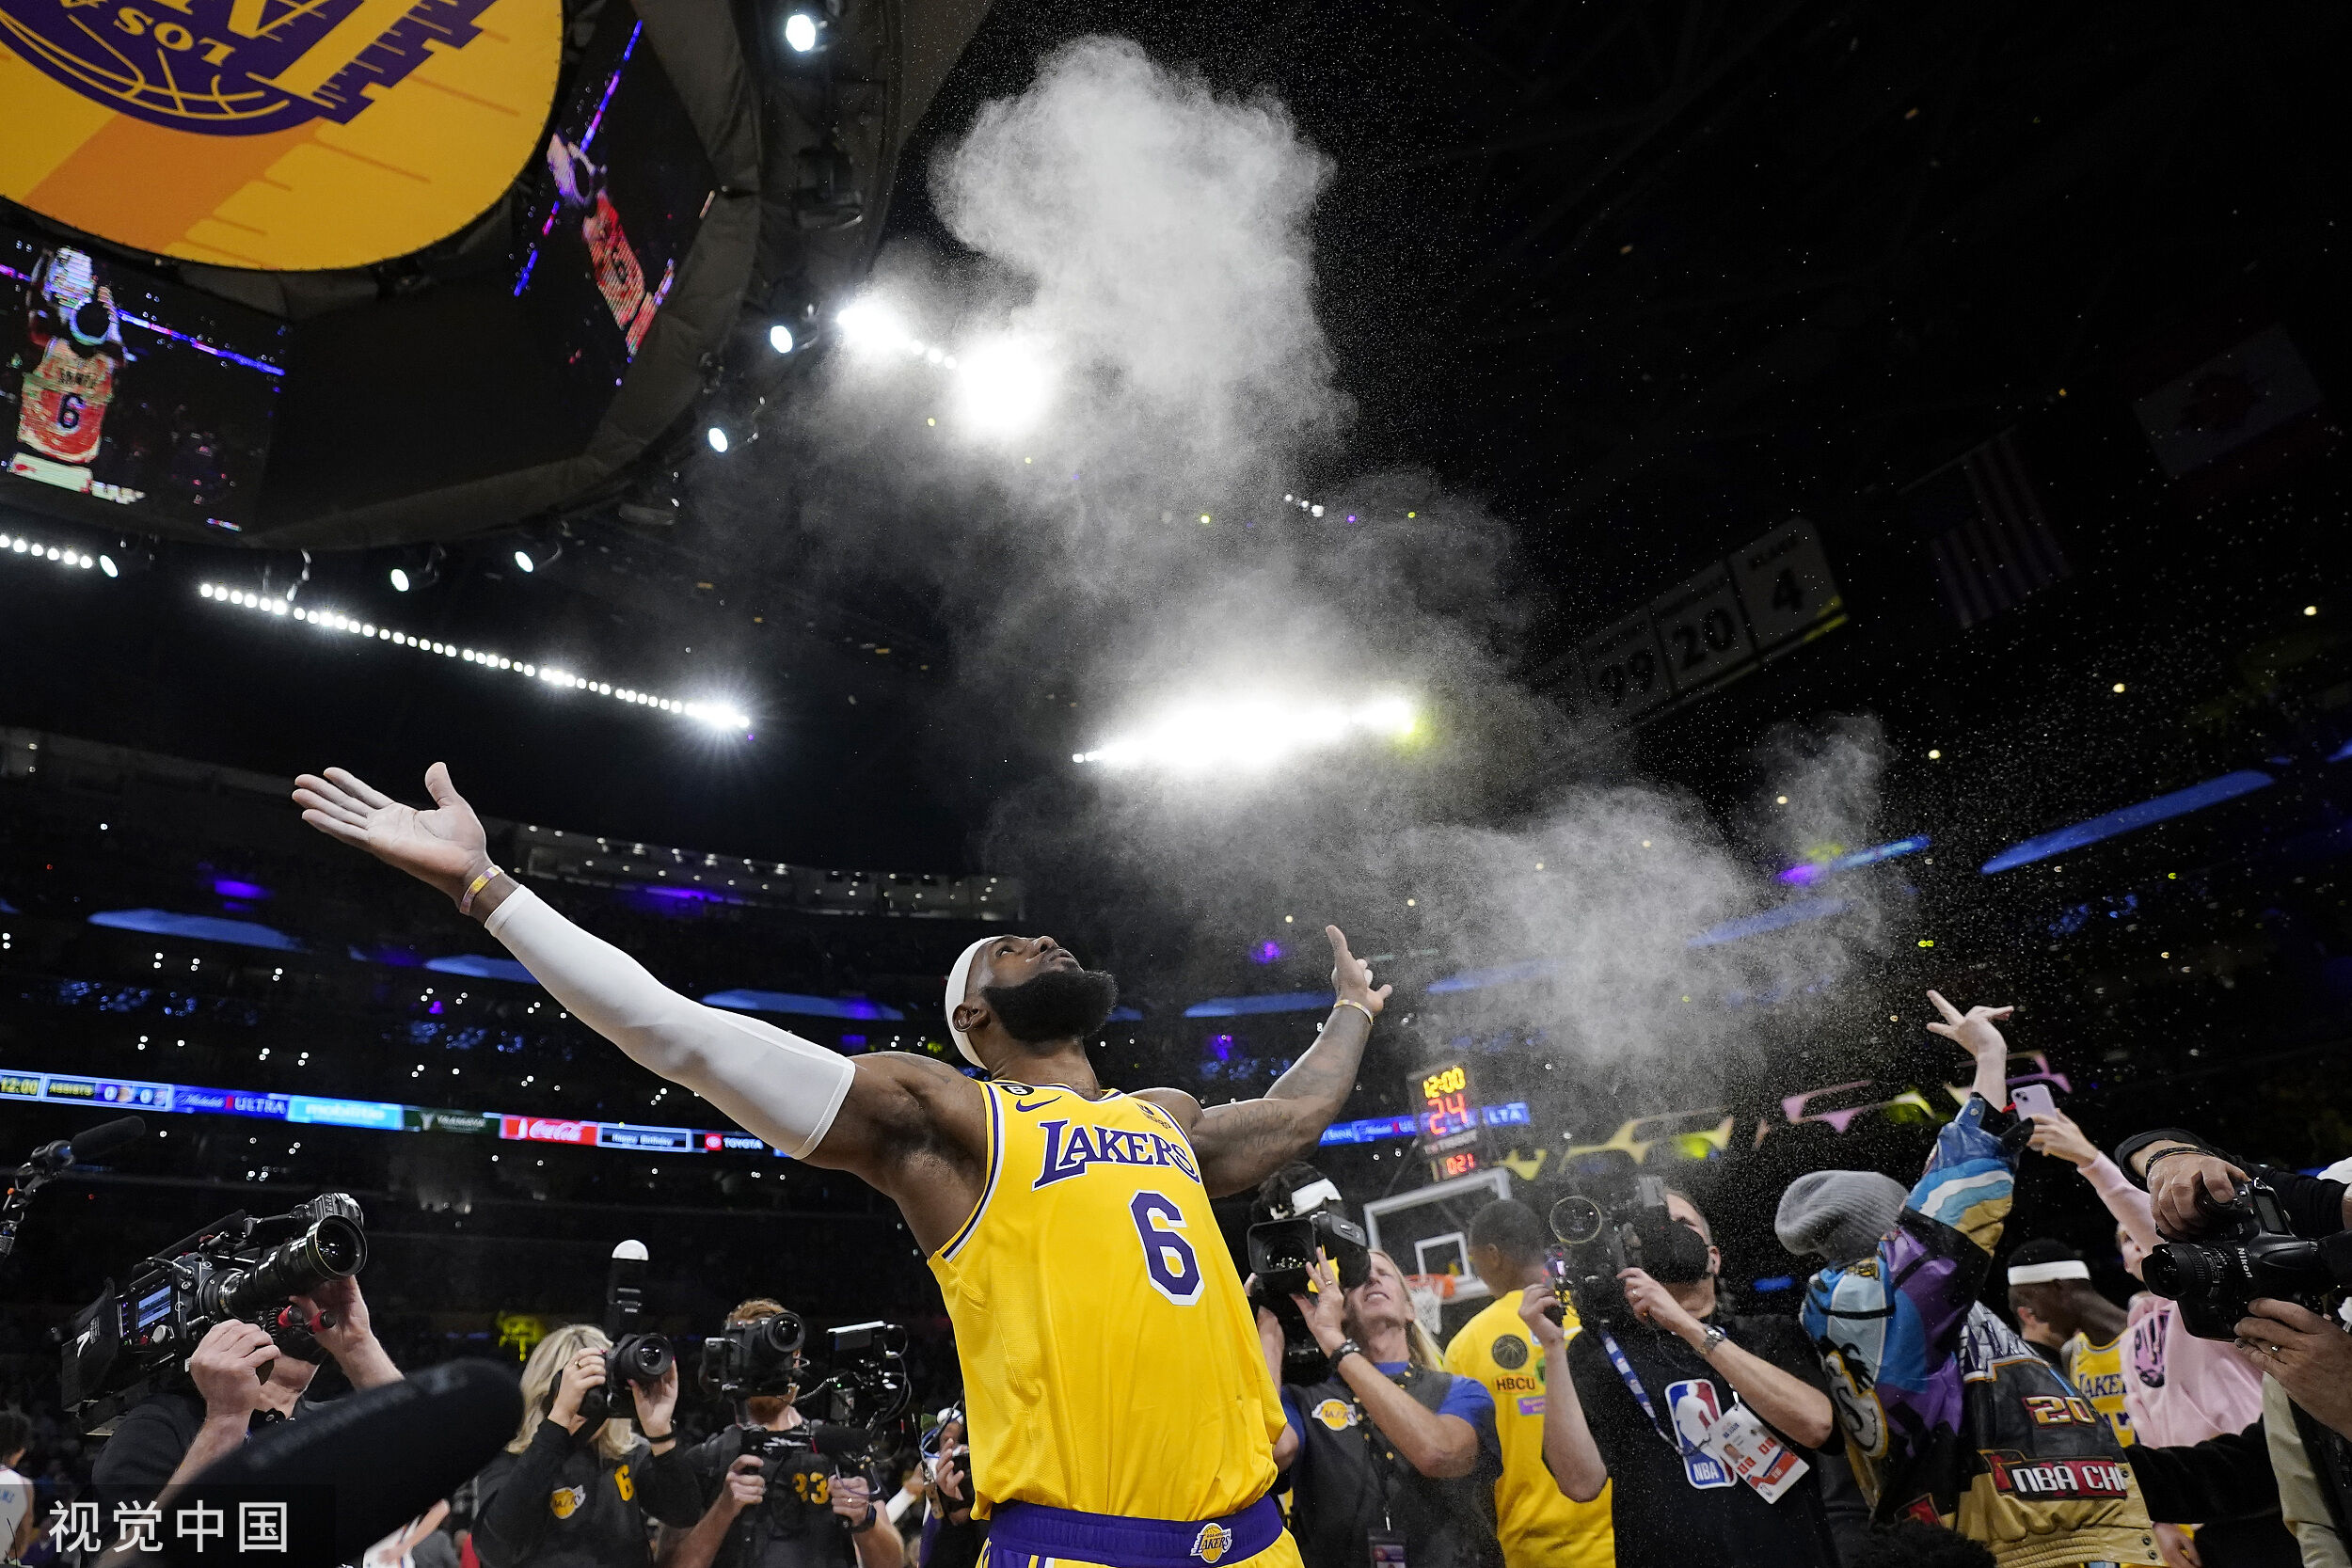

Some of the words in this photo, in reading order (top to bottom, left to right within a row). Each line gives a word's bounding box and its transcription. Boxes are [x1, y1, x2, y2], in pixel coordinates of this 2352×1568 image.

[114, 7, 236, 67] LOS
[57, 391, 87, 430] 6
[1772, 567, 1803, 611] 4
[1673, 607, 1735, 671] 20
[1597, 649, 1656, 707] 99
[1, 1076, 40, 1096] 12:00
[104, 1085, 118, 1101] 0
[139, 1088, 153, 1104] 0
[1423, 1067, 1467, 1099] 12:00
[234, 1095, 287, 1115] ULTRA
[1427, 1093, 1469, 1135] 24
[529, 1119, 583, 1143] Coca-Cola
[612, 1132, 639, 1145] Happy
[639, 1133, 675, 1148] Birthday
[723, 1135, 764, 1150] TOYOTA
[1031, 1118, 1202, 1192] LAKERS
[1129, 1190, 1205, 1307] 6
[2236, 1247, 2254, 1279] Nikon
[1496, 1377, 1536, 1391] HBCU
[2079, 1373, 2128, 1399] LAKE
[2025, 1396, 2097, 1427] 20
[613, 1464, 635, 1501] 6
[1692, 1461, 1720, 1481] NBA
[2010, 1465, 2079, 1493] NBA
[1193, 1534, 1232, 1555] LAKERS
